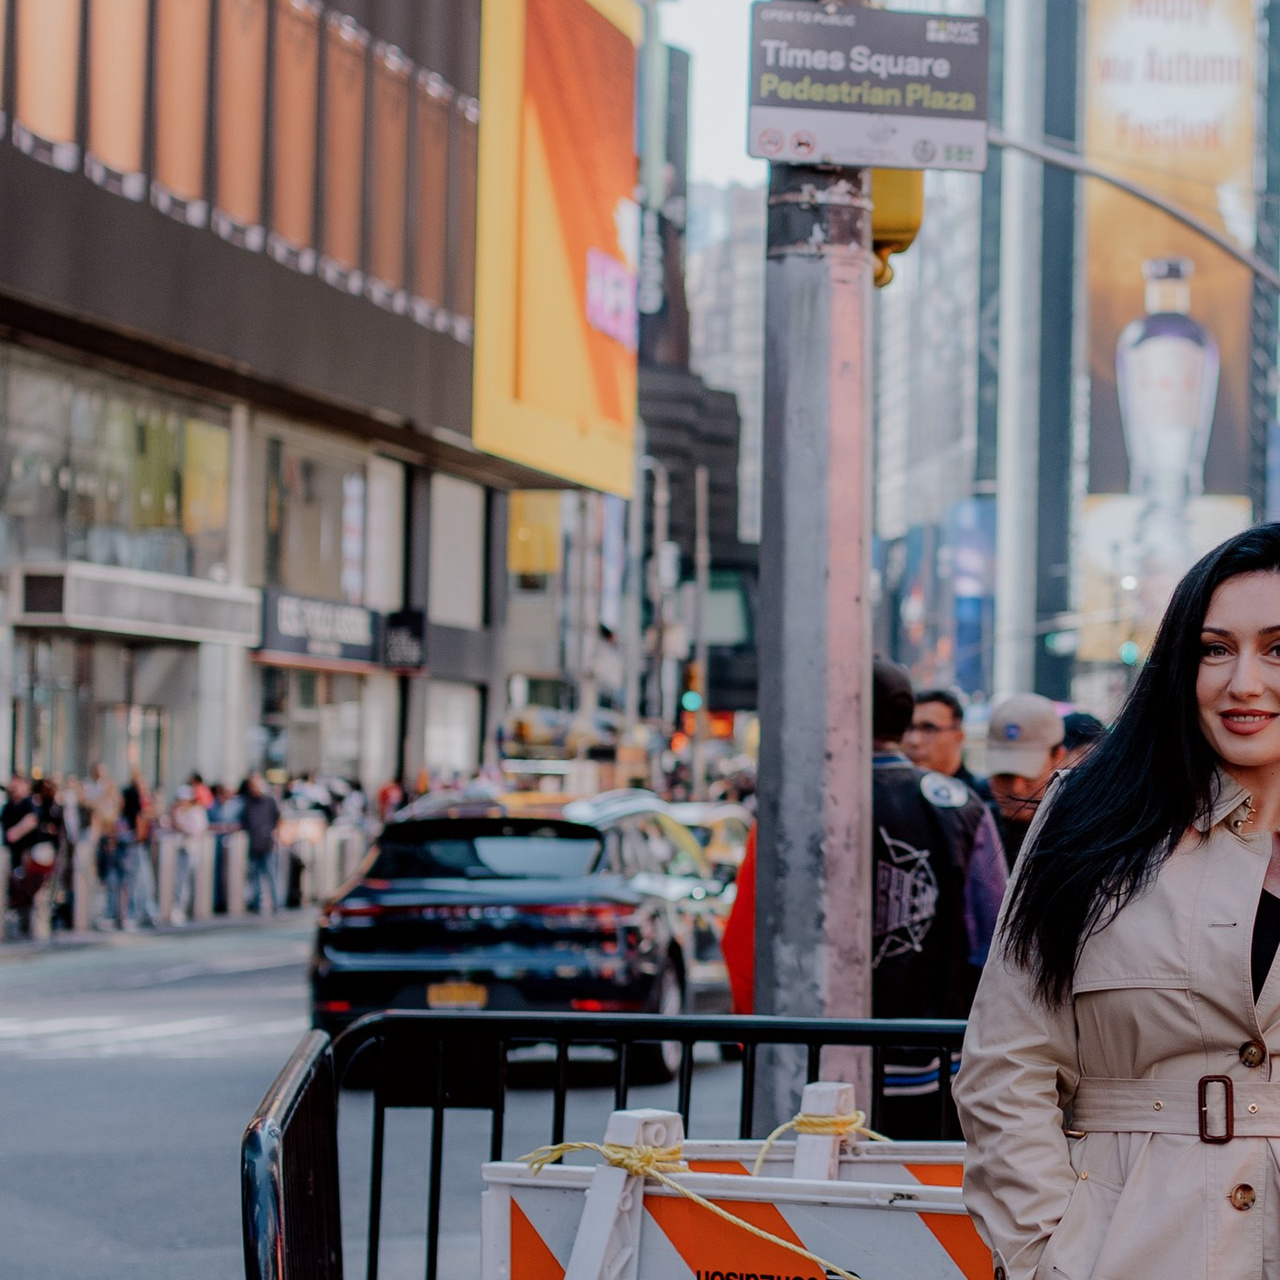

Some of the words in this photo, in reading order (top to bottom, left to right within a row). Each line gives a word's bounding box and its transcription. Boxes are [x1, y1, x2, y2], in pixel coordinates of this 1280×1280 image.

[760, 39, 846, 71] Times
[850, 45, 951, 79] Square
[760, 73, 901, 105] Pedestrian
[906, 82, 977, 111] Plaza
